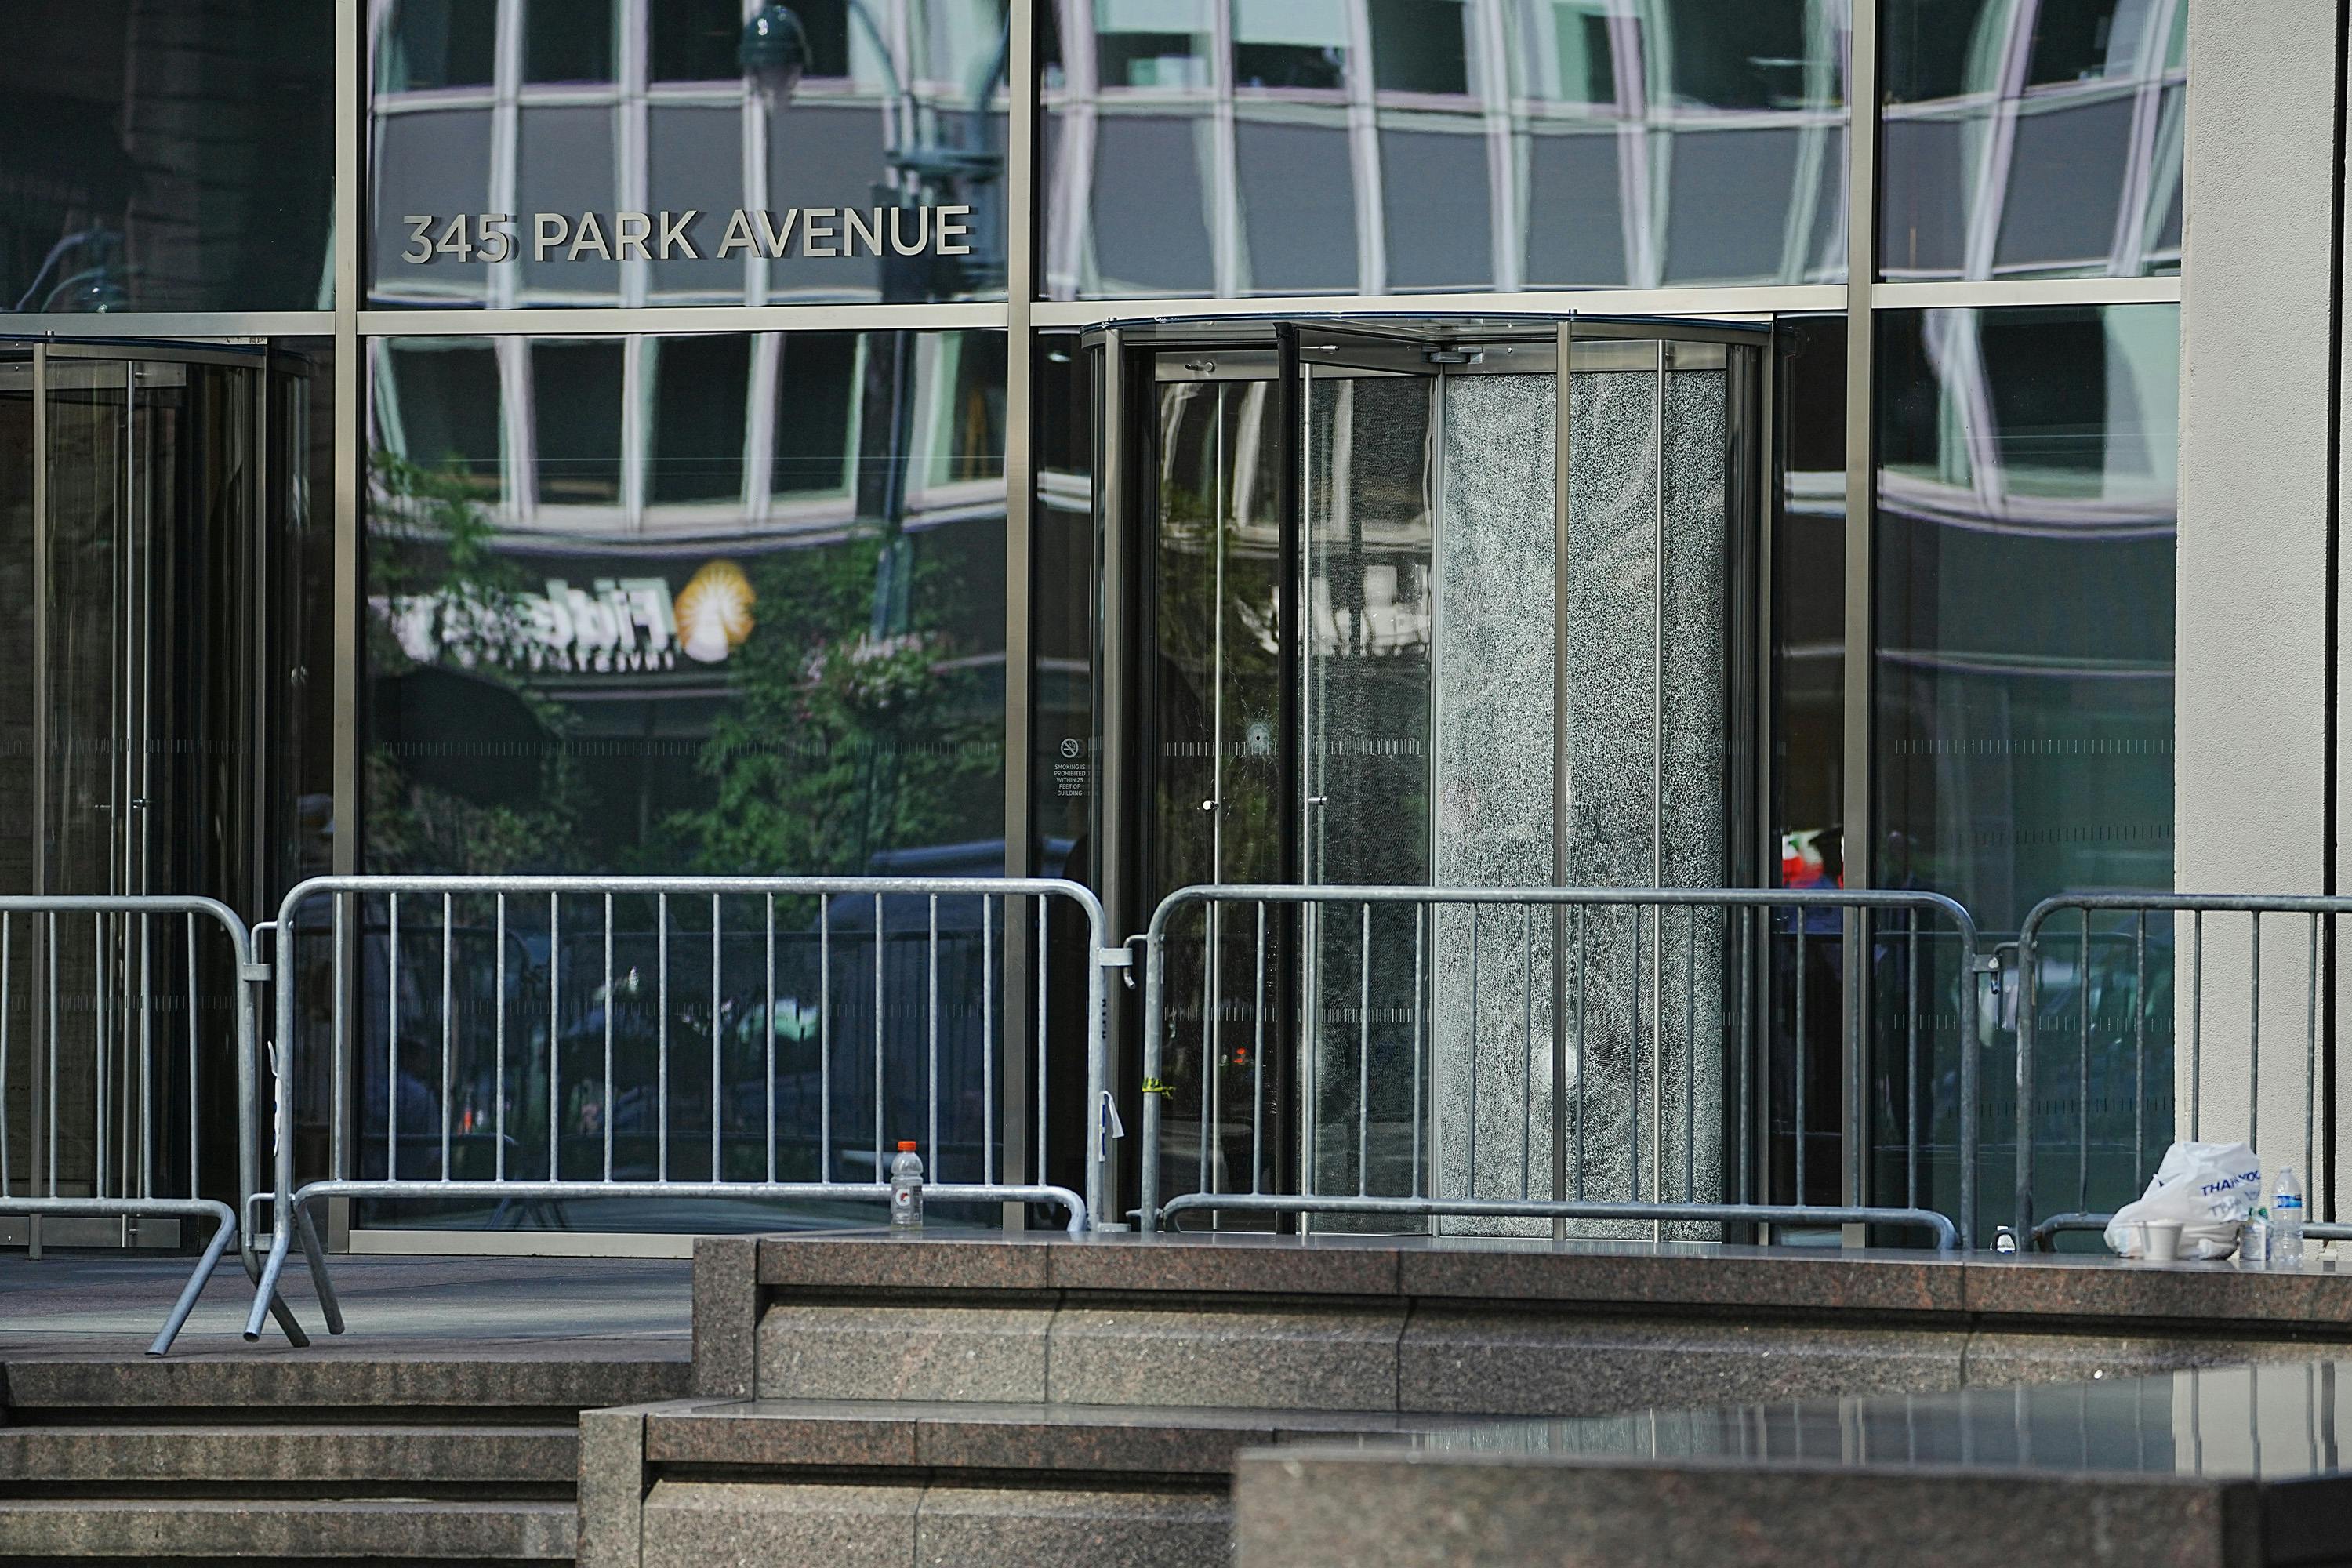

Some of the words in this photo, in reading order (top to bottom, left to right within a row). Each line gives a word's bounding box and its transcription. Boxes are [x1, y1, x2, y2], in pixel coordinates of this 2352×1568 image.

[400, 213, 510, 264] 345
[533, 209, 700, 262] PARK
[716, 205, 971, 259] AVENUE
